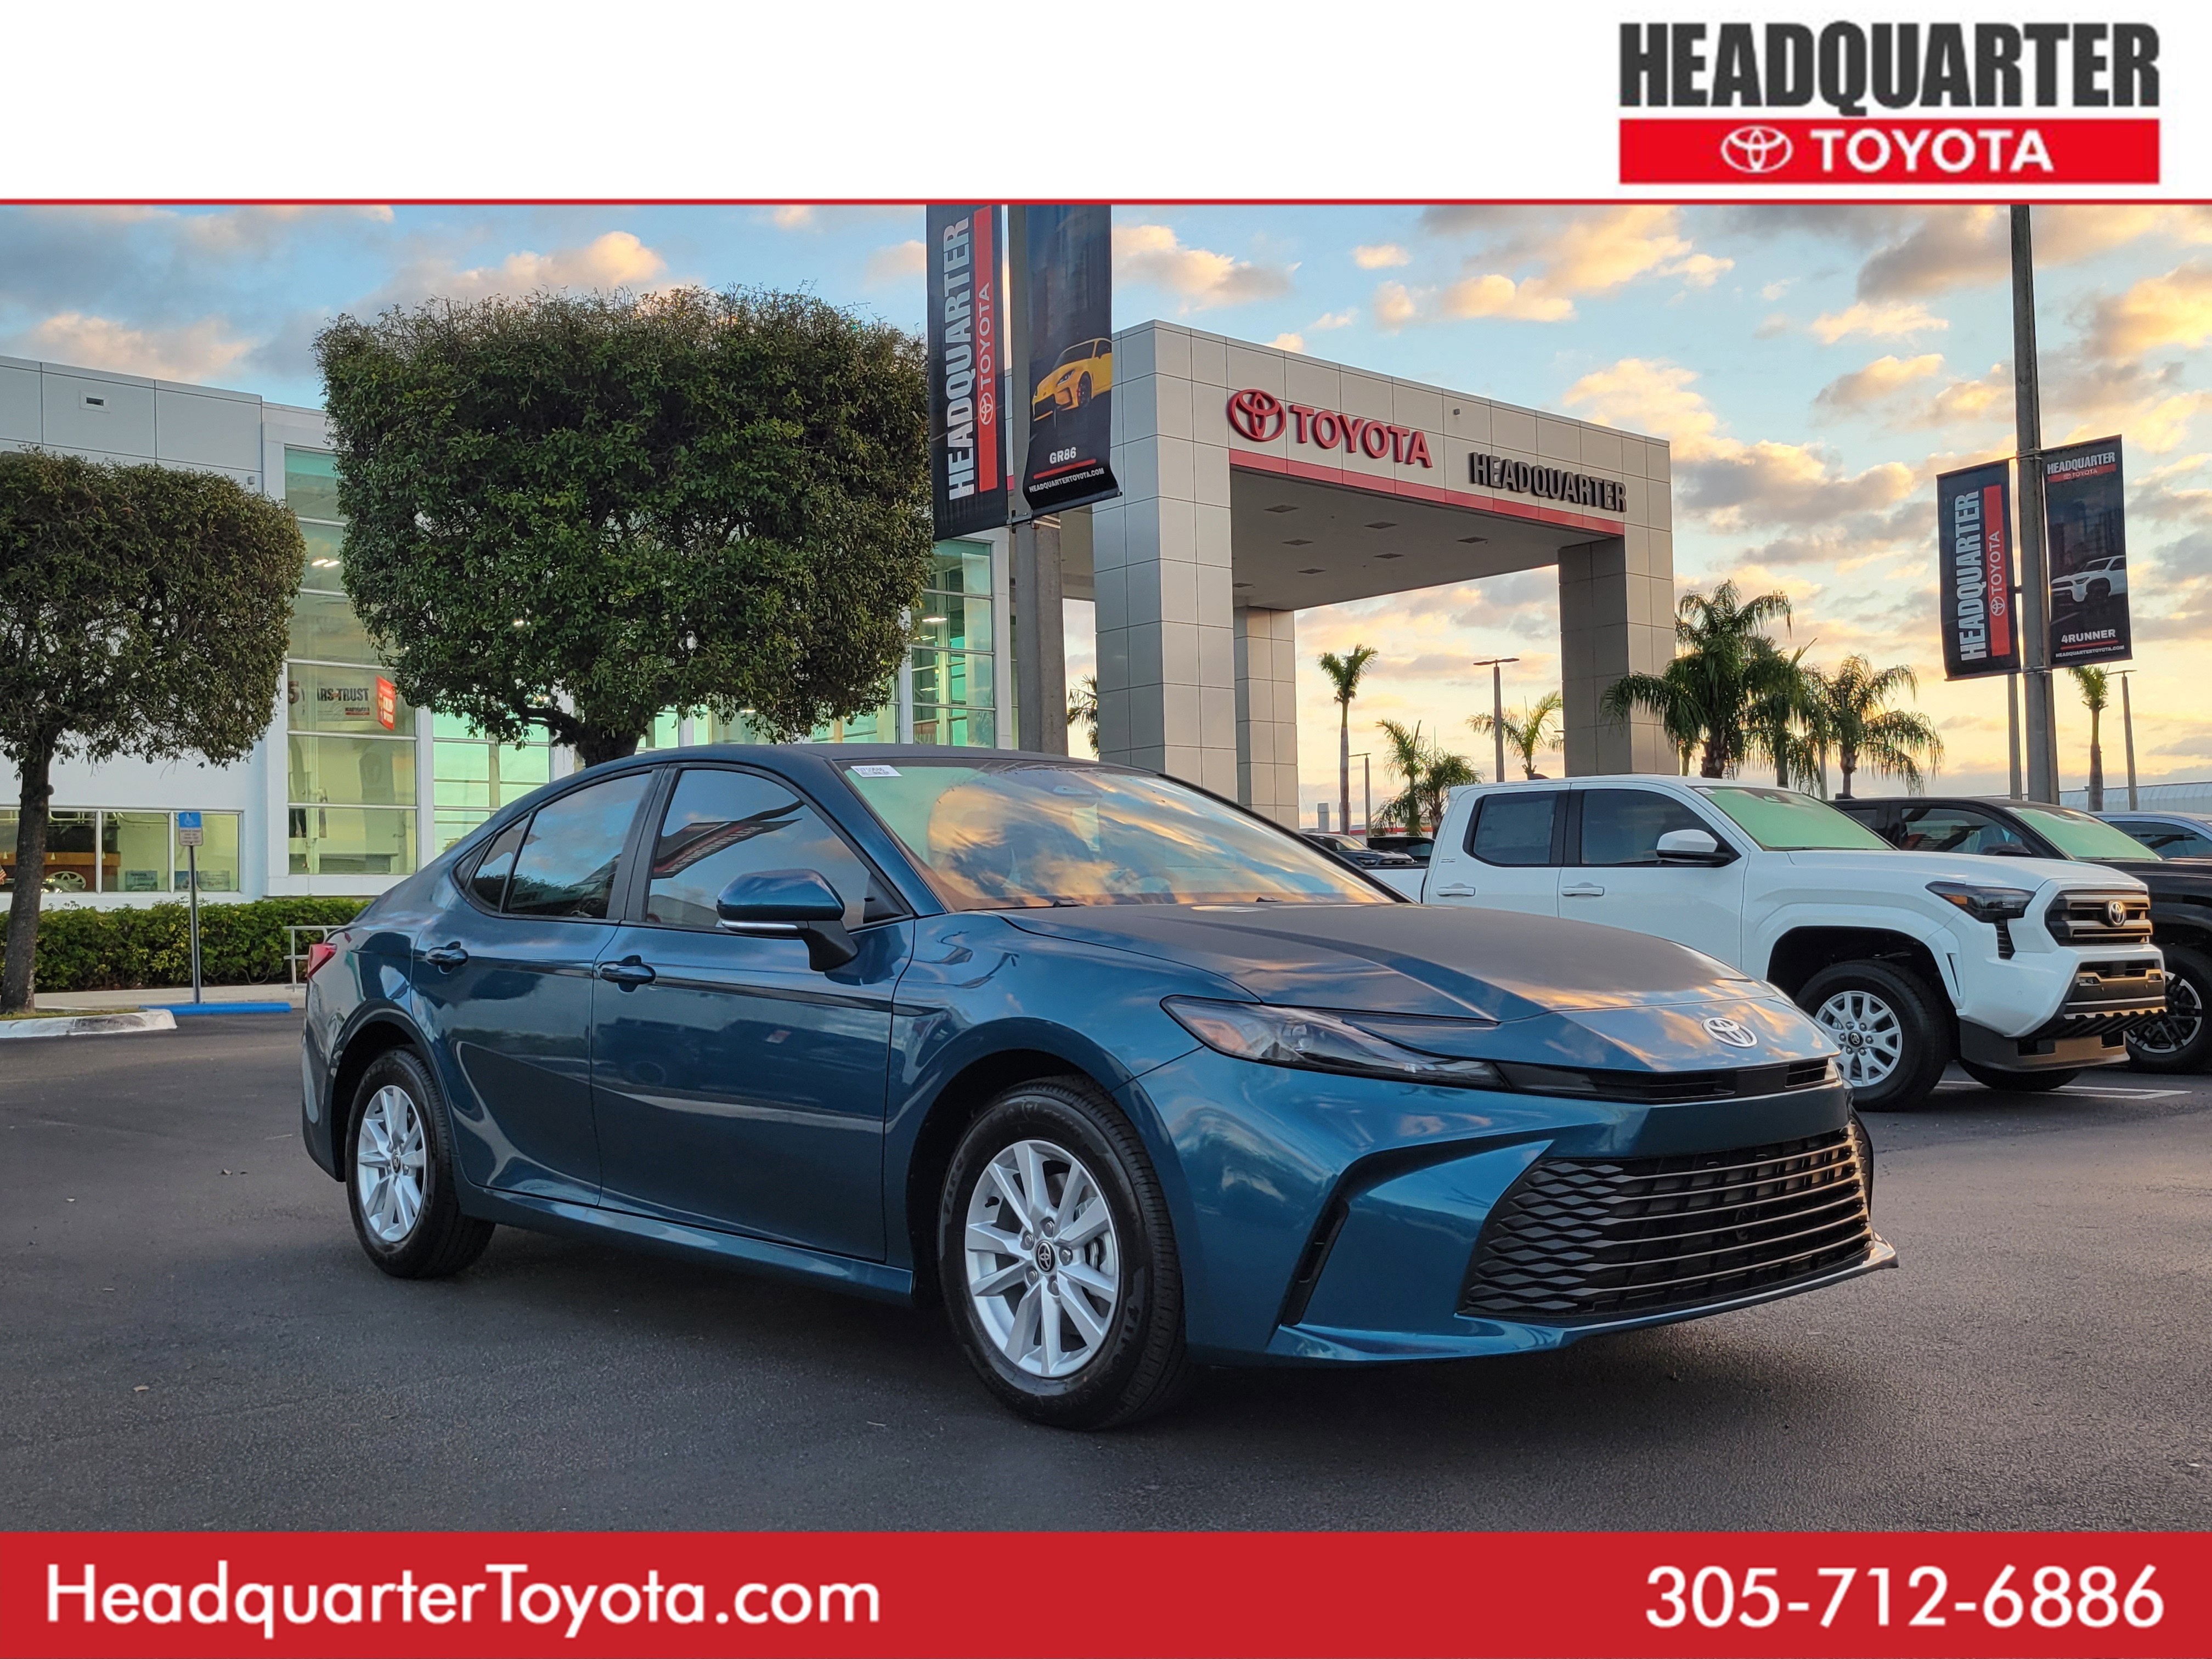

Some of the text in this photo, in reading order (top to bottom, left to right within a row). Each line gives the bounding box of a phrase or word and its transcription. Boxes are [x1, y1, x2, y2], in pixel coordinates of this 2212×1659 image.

[978, 282, 992, 391] TOYOTA
[943, 217, 974, 501] HEADQUARTER
[1049, 447, 1077, 464] GR86
[1289, 404, 1434, 469] TOYOTA
[1029, 467, 1105, 493] HEADQUARTERTOYOTA.COM
[1468, 452, 1628, 512] HEADQUARTER
[2047, 452, 2115, 475] HEADQUARTER
[2072, 469, 2097, 477] TOYOTA
[1954, 490, 1987, 661] HEADQUARTER
[1989, 530, 2002, 595] TOYOTA
[2061, 629, 2117, 644] 4RUNNER
[336, 688, 369, 701] TRUST
